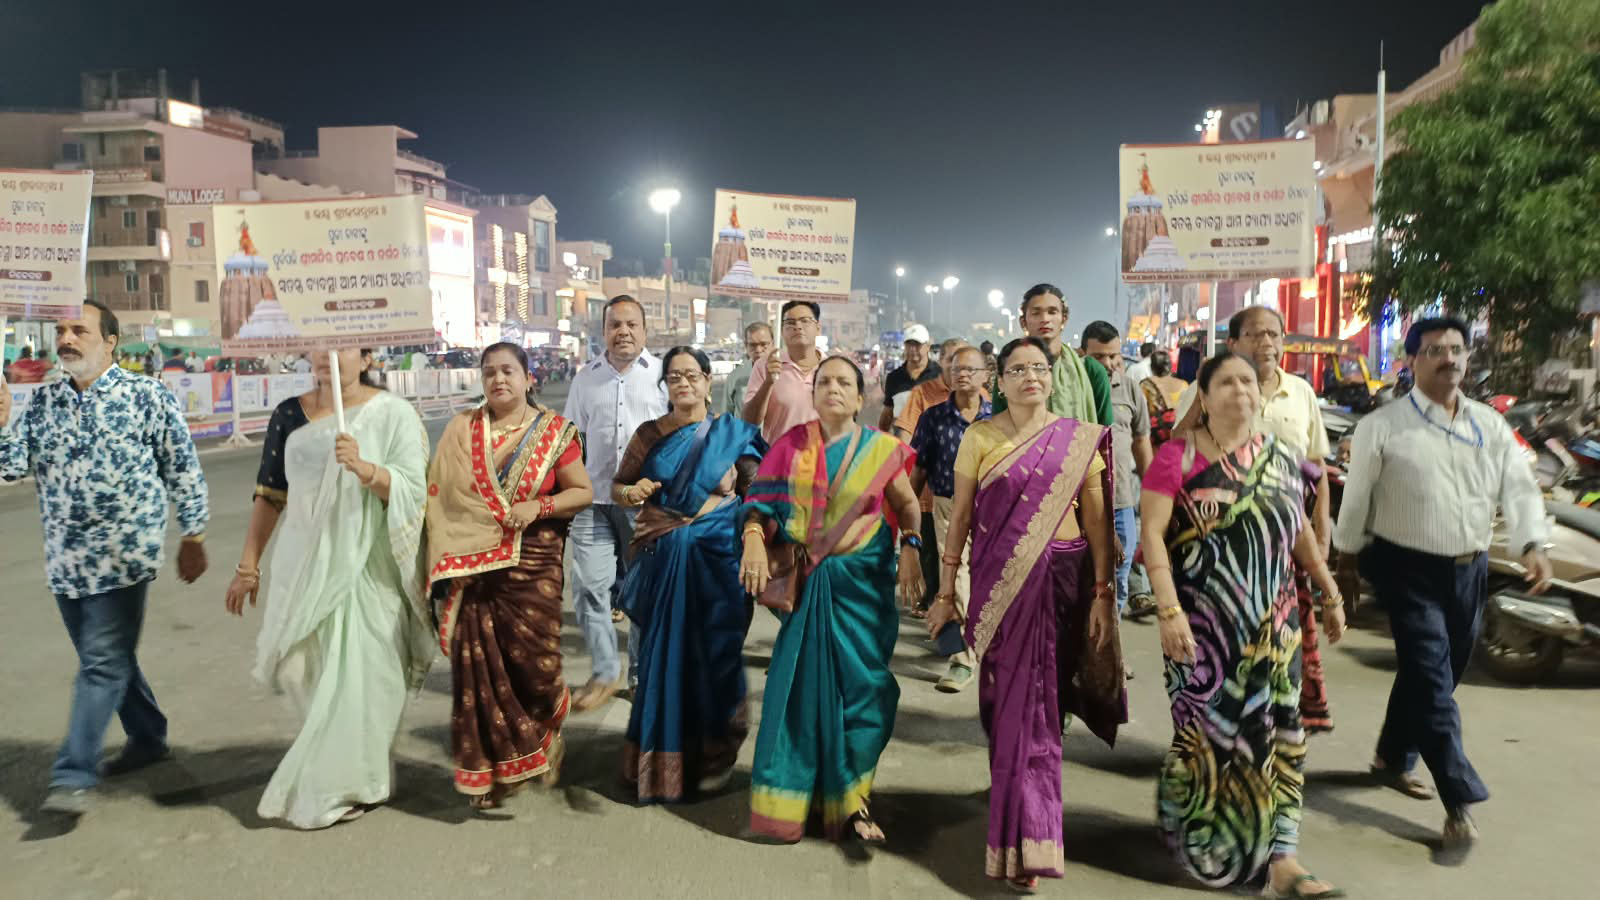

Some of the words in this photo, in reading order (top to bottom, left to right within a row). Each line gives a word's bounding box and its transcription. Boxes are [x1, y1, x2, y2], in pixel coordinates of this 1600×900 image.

[167, 189, 193, 204] MUNA
[194, 189, 225, 203] LODGE
[1226, 215, 1242, 228] ଆମ
[15, 245, 30, 260] ଆମ
[340, 274, 357, 289] ଆମ
